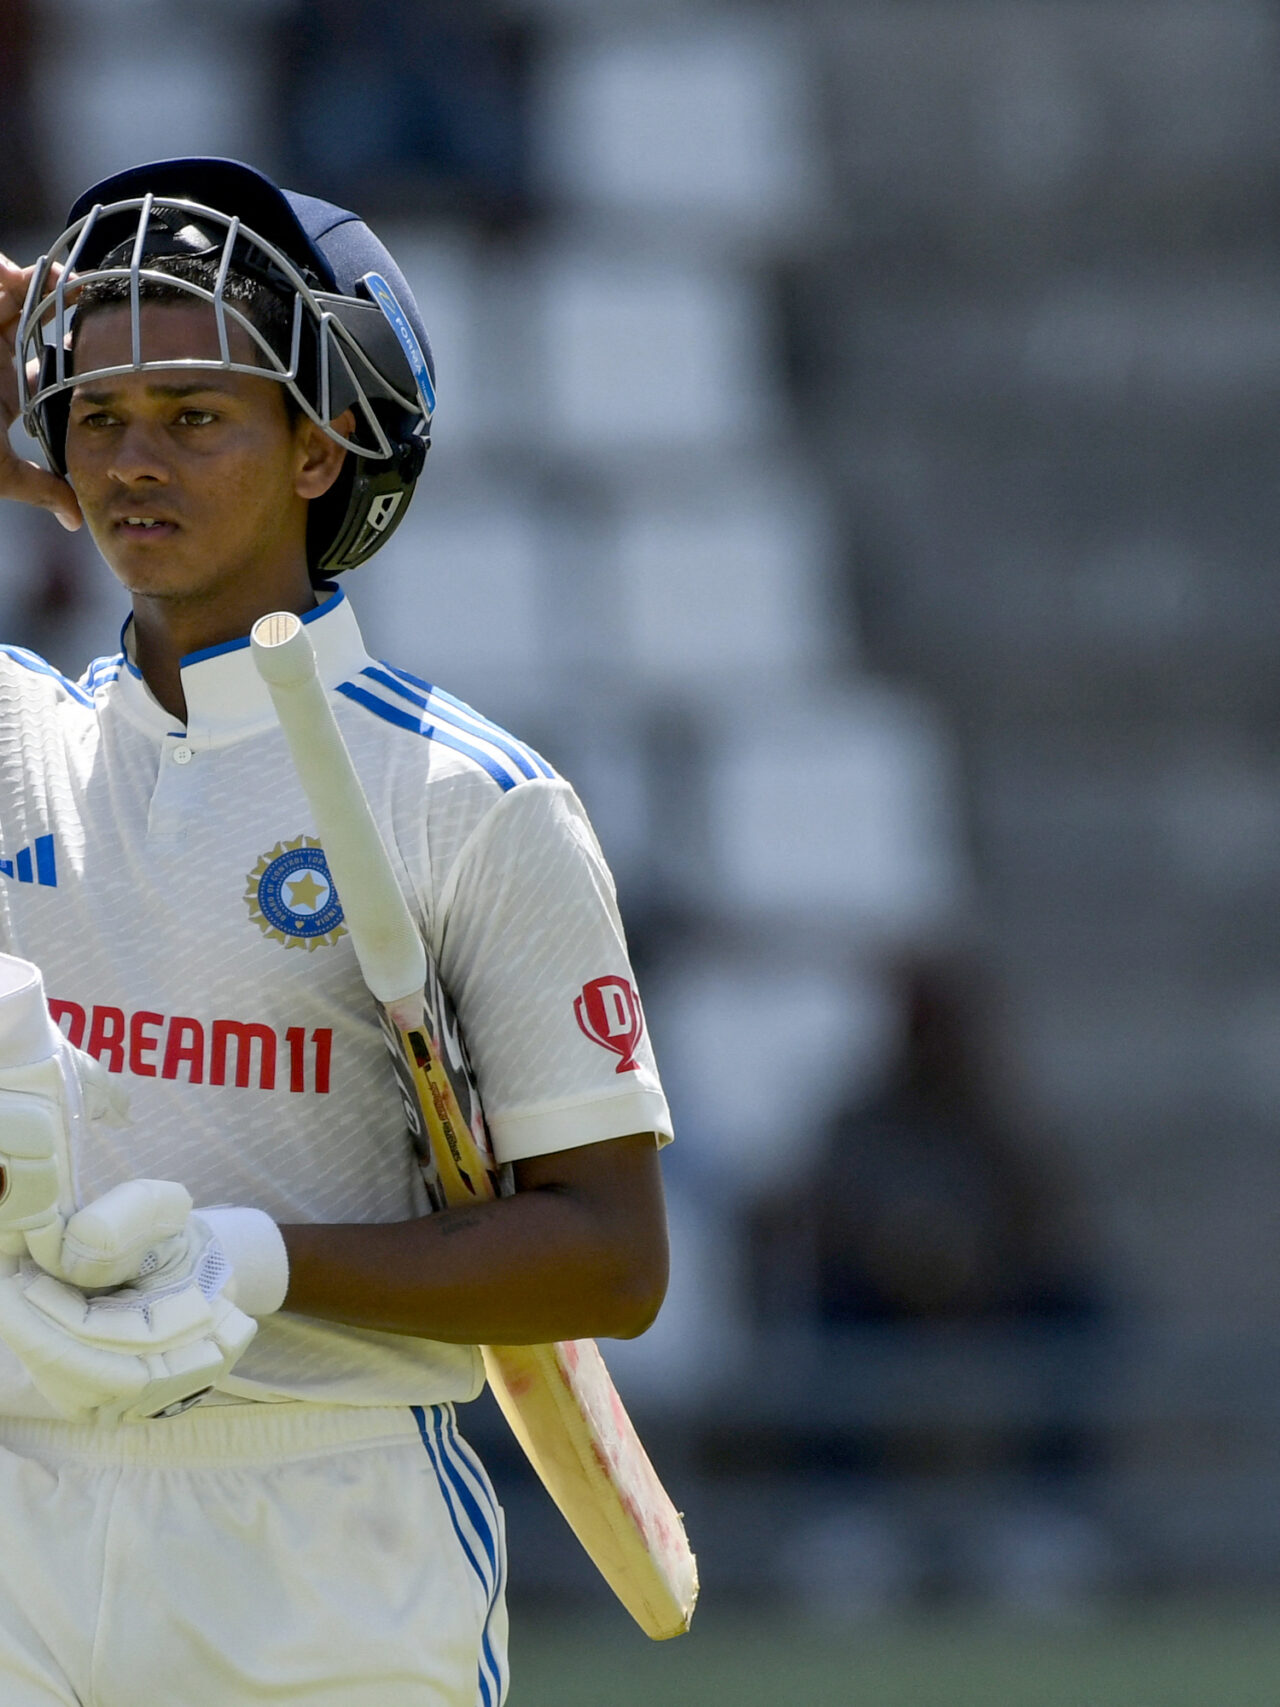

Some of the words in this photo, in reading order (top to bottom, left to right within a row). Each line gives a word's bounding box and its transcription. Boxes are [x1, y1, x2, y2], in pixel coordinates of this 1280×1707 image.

[394, 317, 423, 376] FORMA
[270, 857, 304, 882] CONTROL
[314, 907, 338, 927] INDIA
[48, 997, 333, 1094] DREAM11
